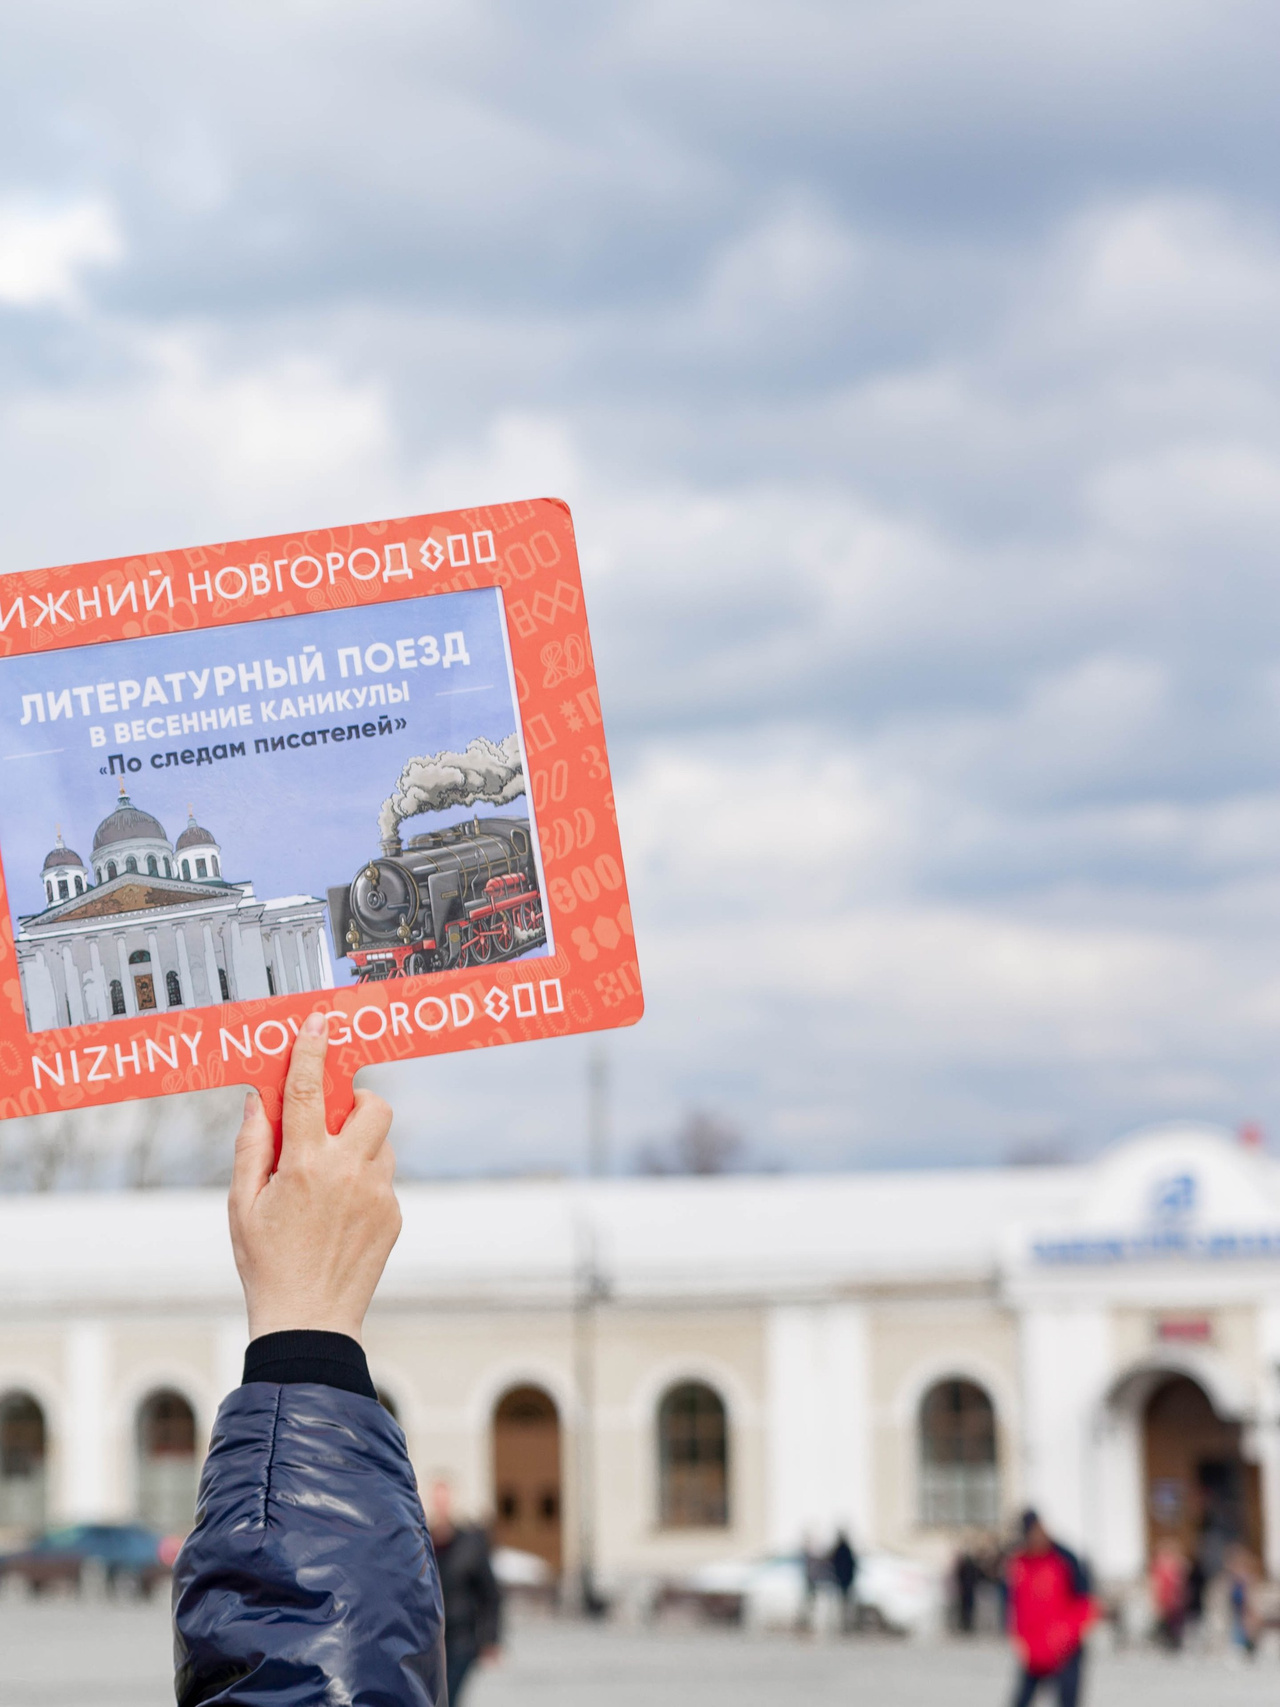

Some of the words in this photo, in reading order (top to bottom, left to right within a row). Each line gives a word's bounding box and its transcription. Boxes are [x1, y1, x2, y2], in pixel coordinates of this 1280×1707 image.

[188, 542, 414, 604] НОВГОРОД
[20, 644, 325, 726] ЛИТЕРАТУРНЫЙ
[337, 631, 471, 678] ПОЕЗД
[89, 726, 107, 748] В
[114, 703, 254, 746] ВЕСЕННИЕ
[261, 680, 410, 723] КАНИКУЛЫ
[98, 754, 143, 777] «По
[150, 742, 246, 771] следам
[254, 714, 408, 755] писателей»
[31, 1030, 203, 1090] NIZHNY
[218, 993, 475, 1062] NOGOROD
